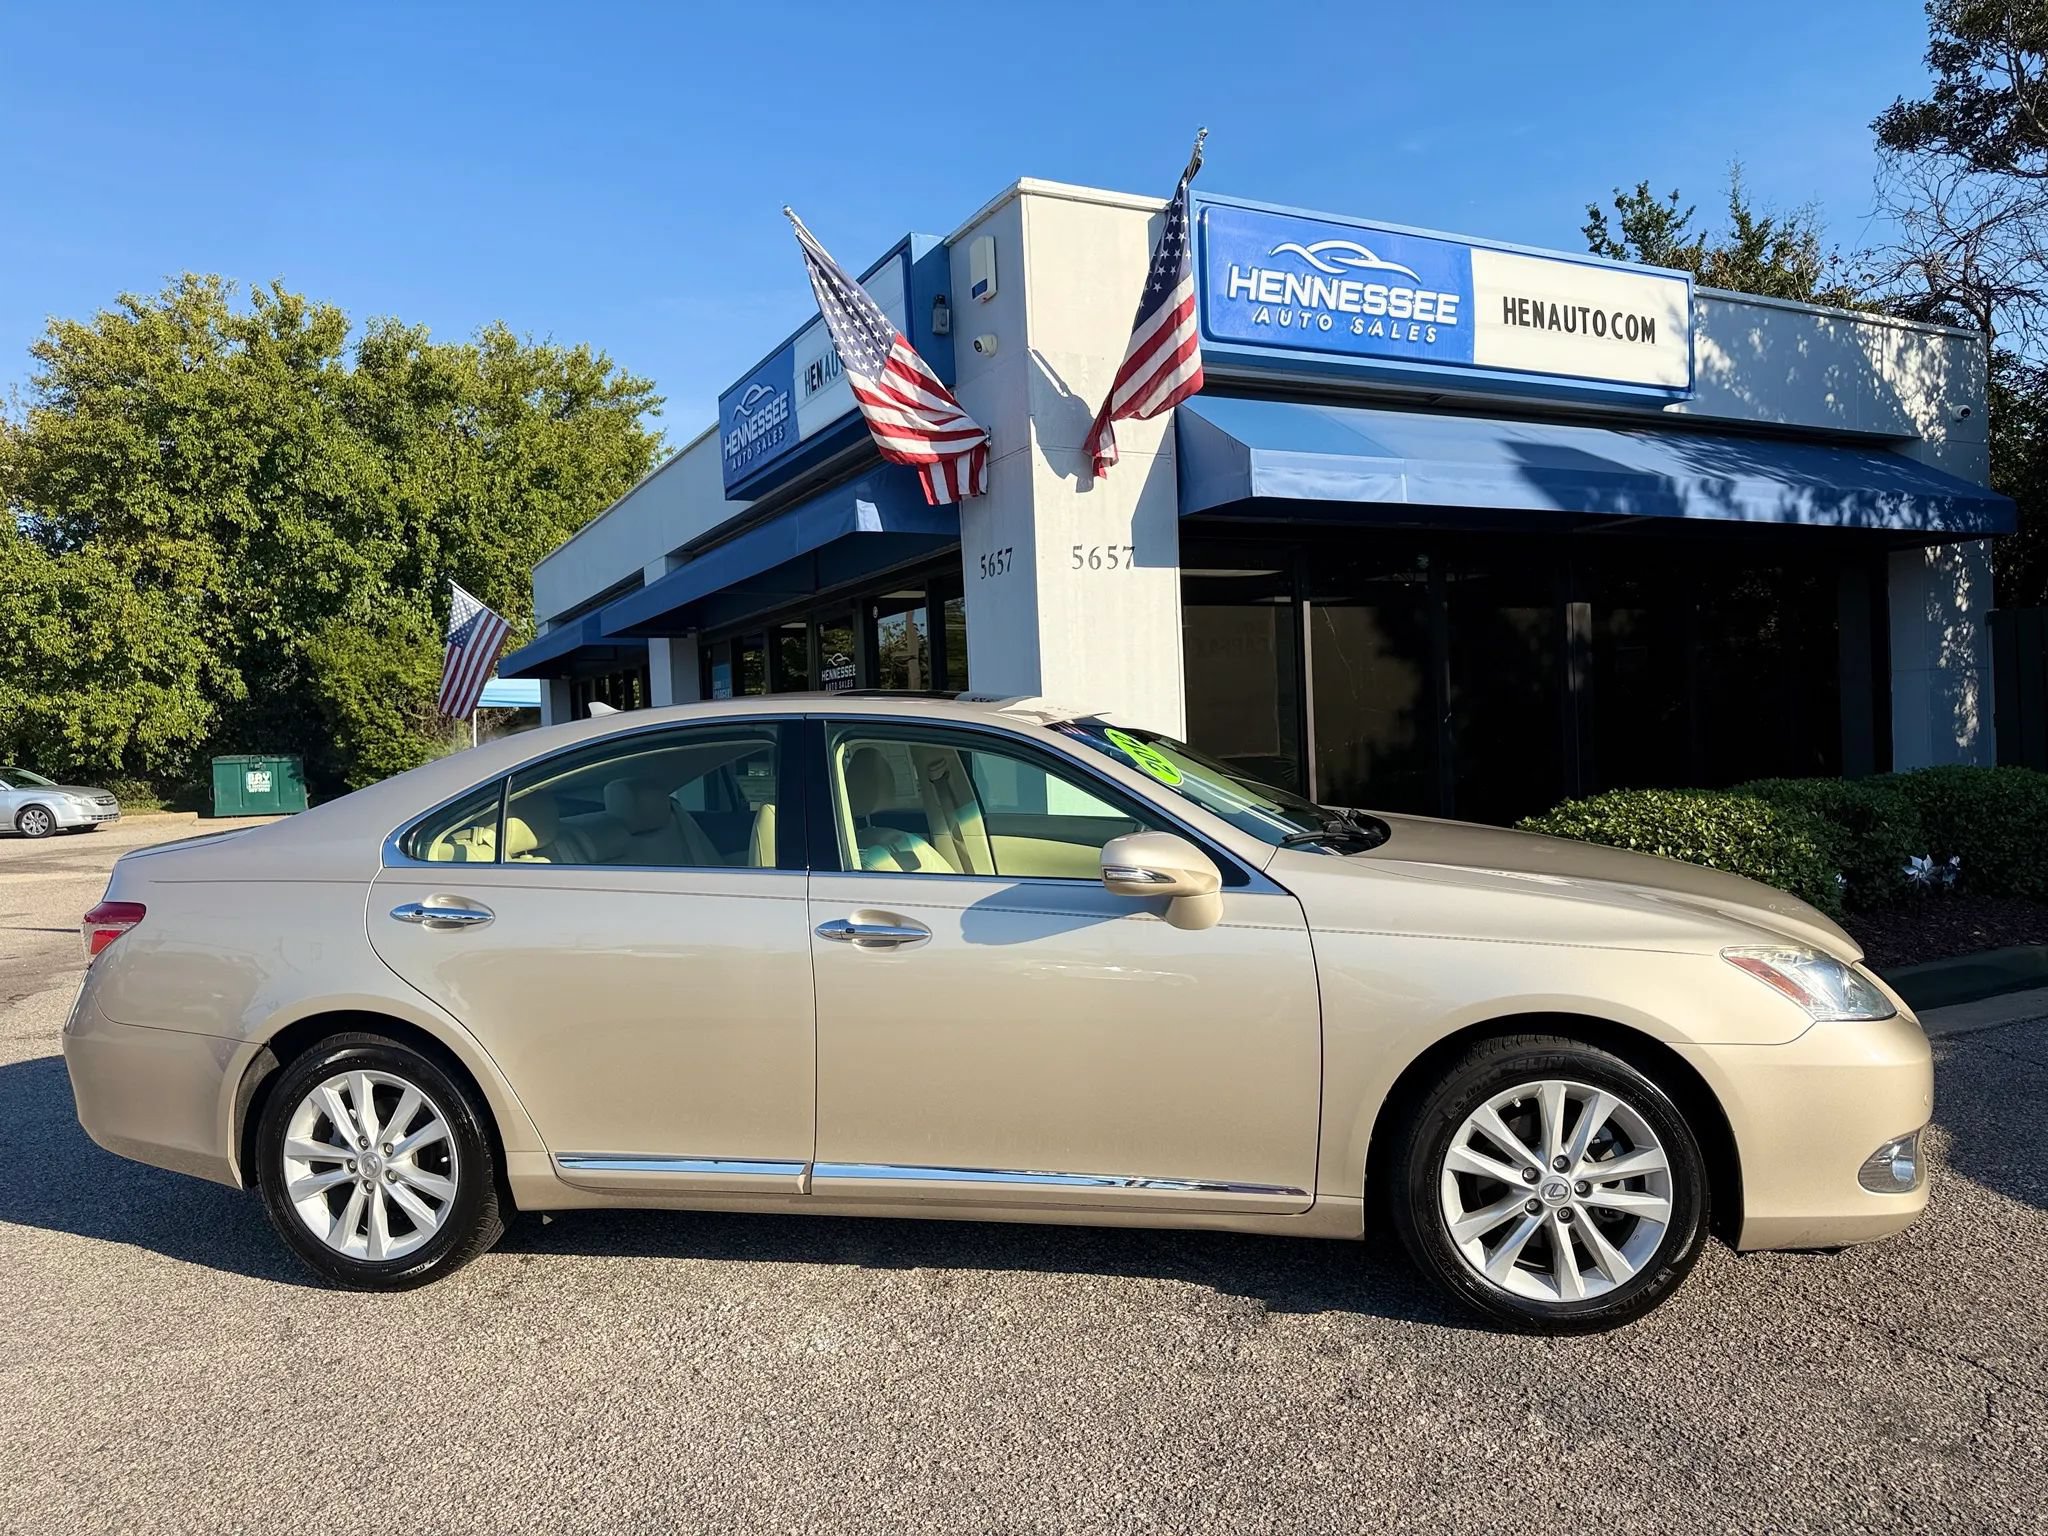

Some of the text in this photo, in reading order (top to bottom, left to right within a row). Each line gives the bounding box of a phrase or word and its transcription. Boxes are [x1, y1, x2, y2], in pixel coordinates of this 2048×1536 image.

[1227, 262, 1461, 325] HENNESSEE
[1253, 305, 1438, 344] AUTO SALES
[724, 390, 789, 461] HENNESSEE
[732, 426, 785, 472] AUTO SALES
[980, 547, 1013, 580] 5657
[1072, 544, 1136, 570] 5657
[821, 664, 856, 682] HENNESSEE
[838, 679, 854, 689] SALES
